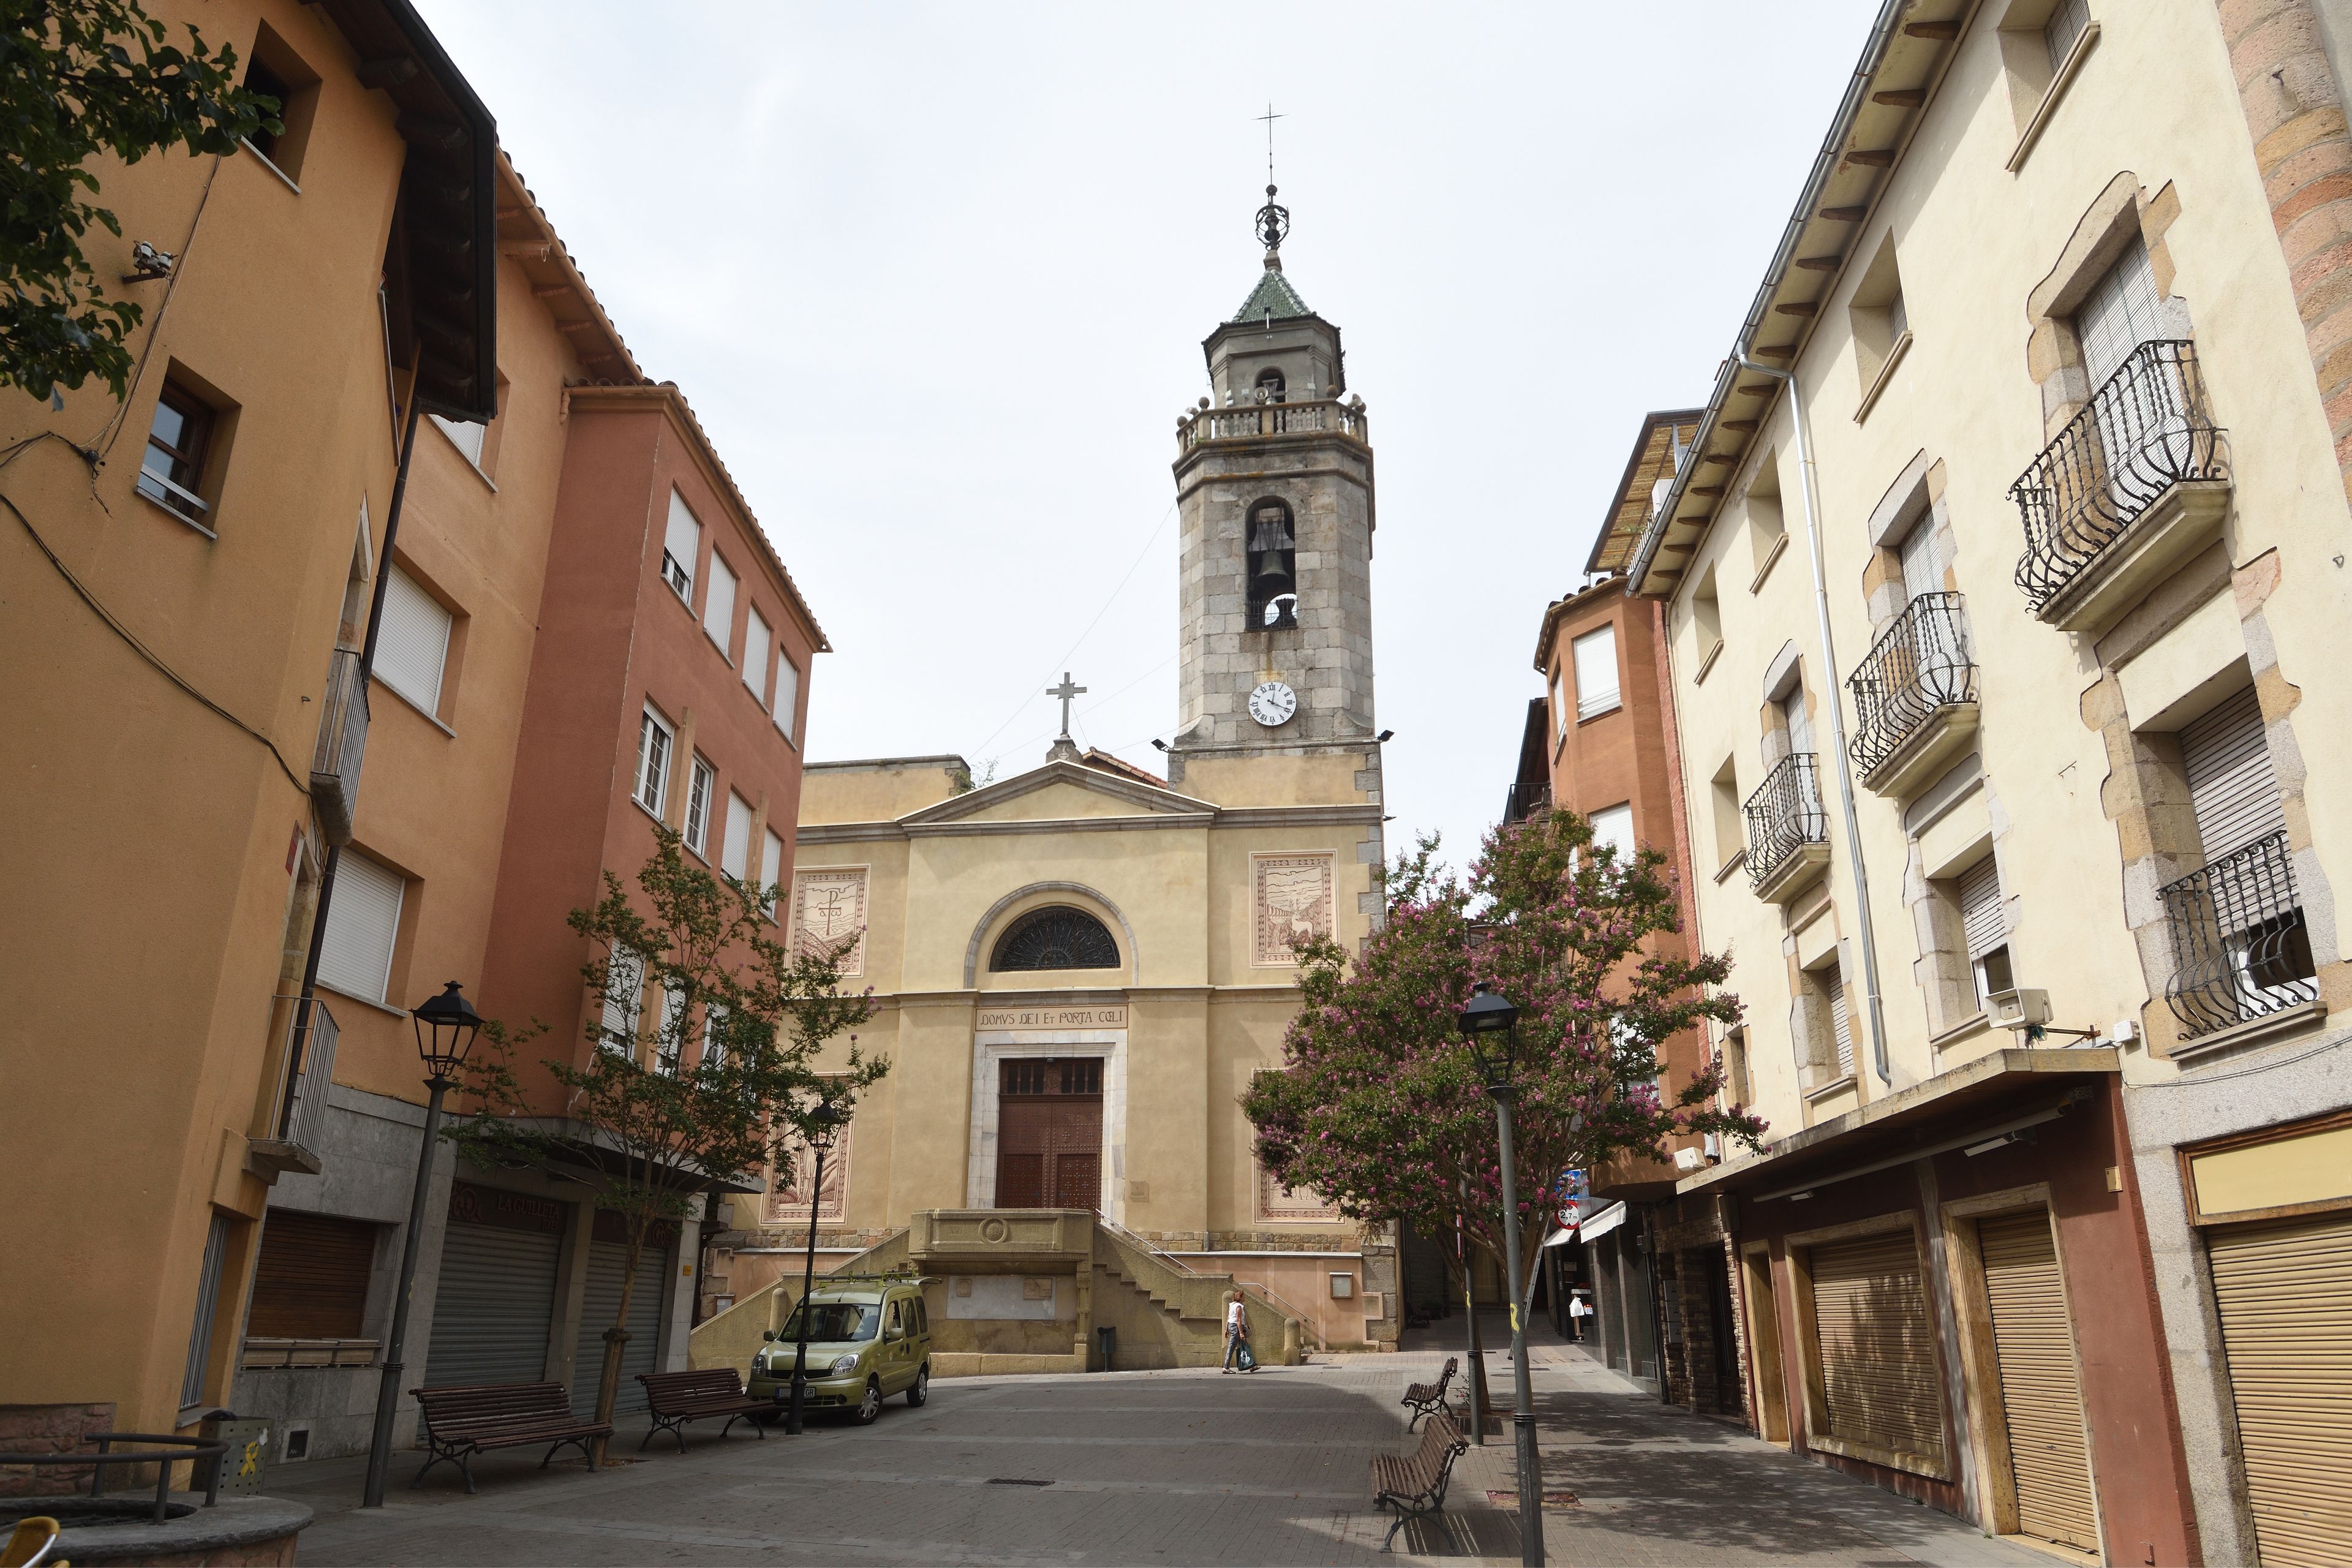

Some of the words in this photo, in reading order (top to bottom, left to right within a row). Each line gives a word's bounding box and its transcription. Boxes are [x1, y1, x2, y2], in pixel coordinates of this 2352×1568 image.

[981, 1013, 1015, 1025] DOMVS
[1019, 1013, 1039, 1024] DEI
[1059, 1012, 1093, 1025] PORTA
[498, 1195, 511, 1212] LA
[513, 1198, 559, 1219] GUILLETA
[542, 1219, 559, 1231] JOIES
